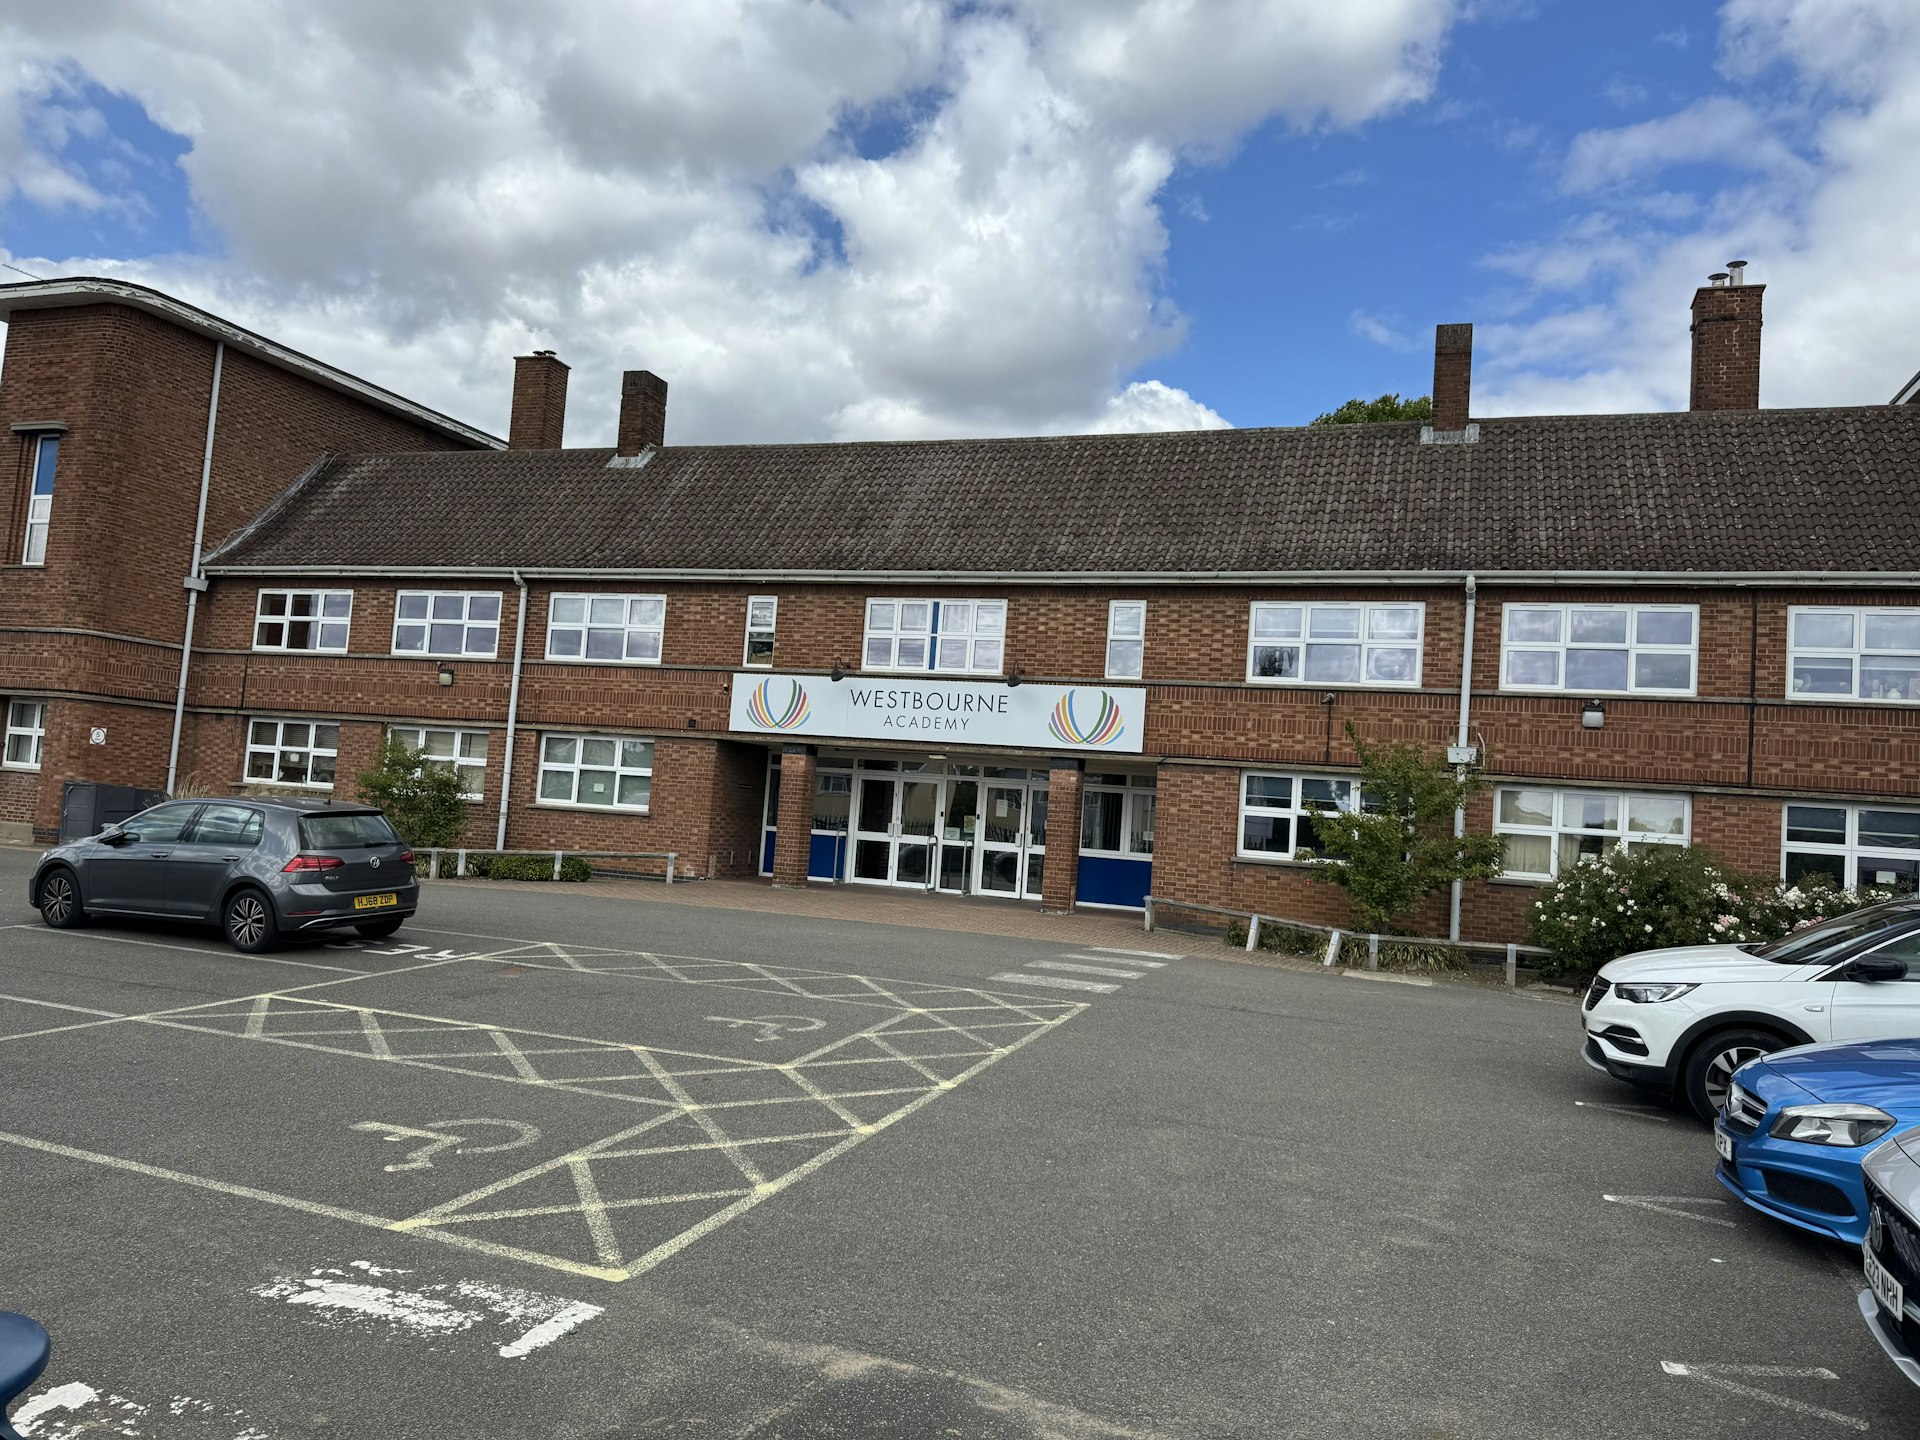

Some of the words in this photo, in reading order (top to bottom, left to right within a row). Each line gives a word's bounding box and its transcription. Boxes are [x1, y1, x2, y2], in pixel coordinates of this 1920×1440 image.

[850, 689, 1008, 713] WESTBOURNE
[883, 715, 969, 730] ACADEMY
[357, 896, 377, 907] HJ68
[379, 894, 393, 905] ZDP
